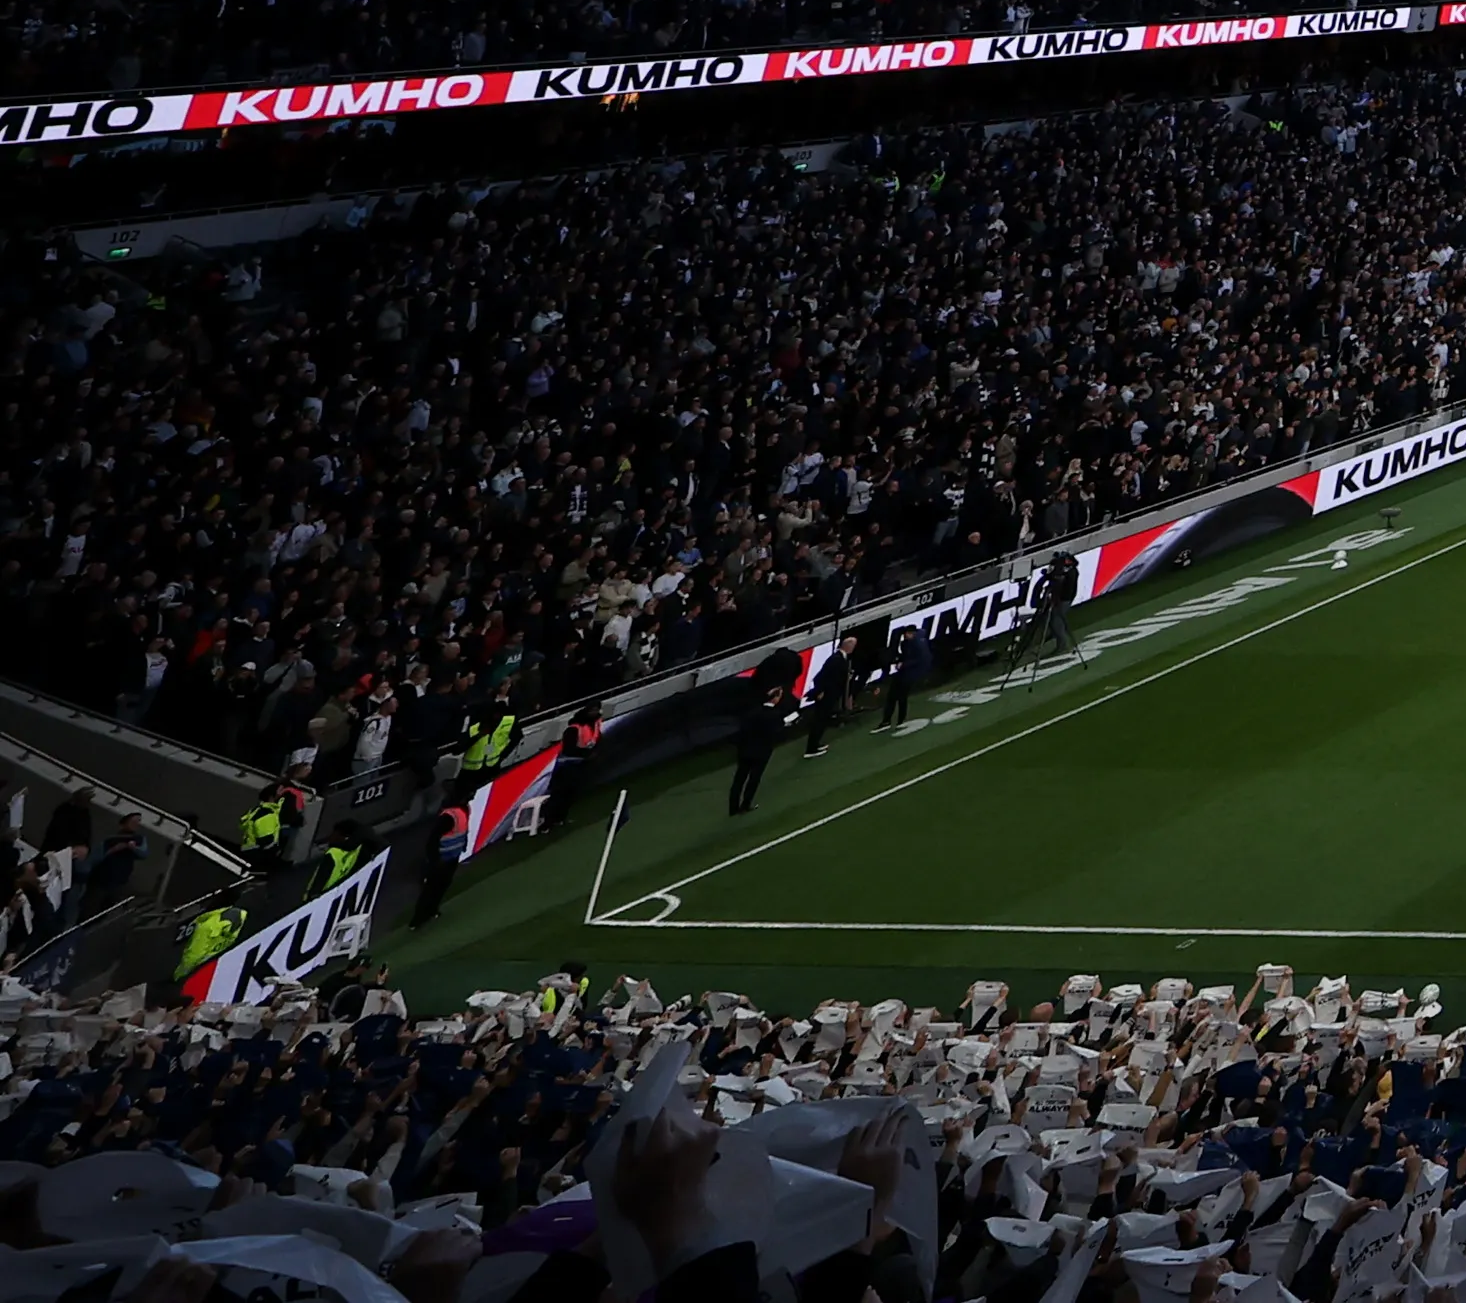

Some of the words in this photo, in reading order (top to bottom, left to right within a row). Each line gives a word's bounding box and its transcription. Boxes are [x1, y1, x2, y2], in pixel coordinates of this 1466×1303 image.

[1156, 18, 1275, 47] KUMHO
[1298, 10, 1398, 36] KUMHO
[784, 41, 955, 78] KUMHO
[987, 29, 1129, 61] KUMHO
[534, 57, 744, 99] KUMHO
[218, 75, 484, 125] KUMHO
[110, 230, 140, 244] 102
[354, 783, 385, 805] 101
